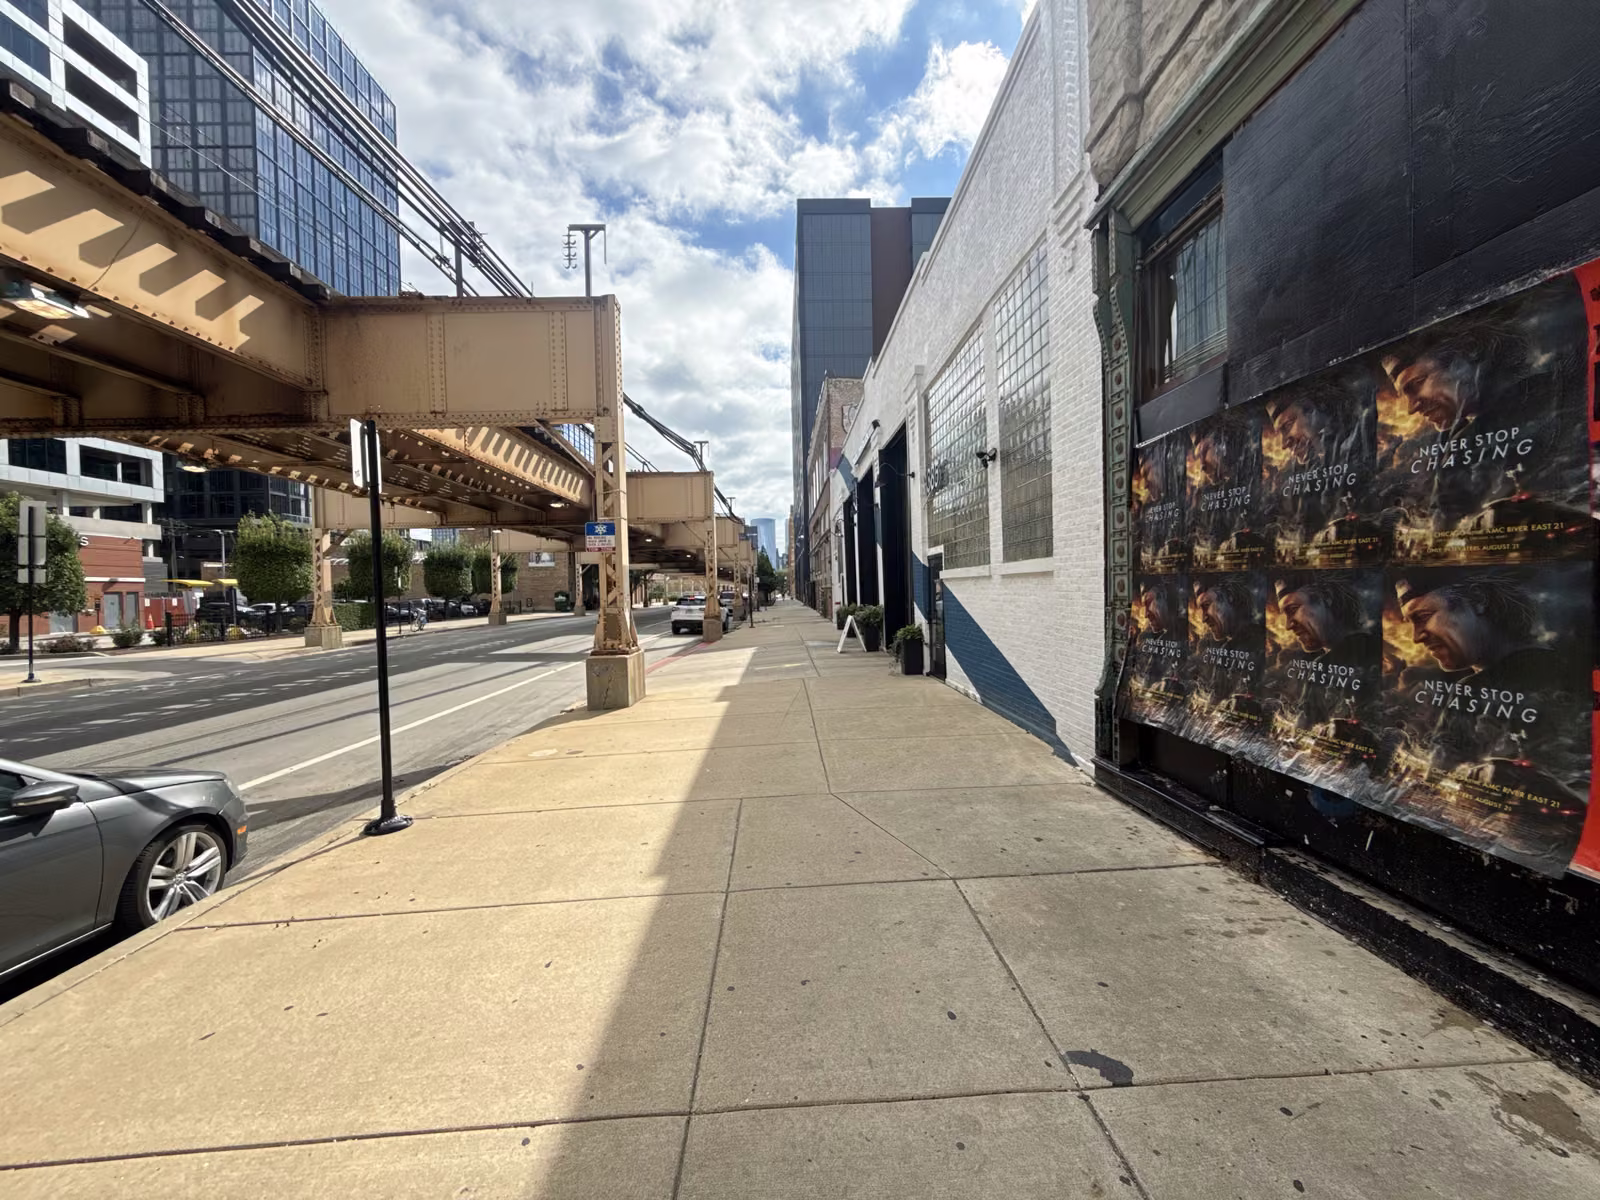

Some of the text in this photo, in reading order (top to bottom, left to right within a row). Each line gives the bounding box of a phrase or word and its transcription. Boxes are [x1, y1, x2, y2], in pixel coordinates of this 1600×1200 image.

[1419, 427, 1520, 458] NEVER STOP
[1410, 439, 1533, 474] CHASING
[1288, 463, 1349, 484] NEVER STOP
[1228, 486, 1247, 497] STOP
[1282, 473, 1357, 497] CHASING
[1200, 494, 1250, 511] CHASING
[1486, 527, 1505, 535] AMC
[1507, 525, 1529, 533] RIVER
[1531, 523, 1552, 531] EAST
[1553, 522, 1565, 530] 21
[1141, 645, 1181, 658] CHASING
[1145, 638, 1178, 649] NEVER STOP
[1202, 654, 1255, 671] CHASING
[1206, 647, 1250, 660] NEVER STOP
[1292, 659, 1355, 676] NEVER STOP
[1286, 667, 1361, 690] CHASING
[1424, 679, 1524, 704] NEVER STOP
[1415, 690, 1538, 723] CHASING
[1482, 782, 1501, 792] AMC
[1502, 786, 1525, 799] RIVER
[1527, 793, 1549, 805] EAST
[1550, 799, 1561, 809] 21
